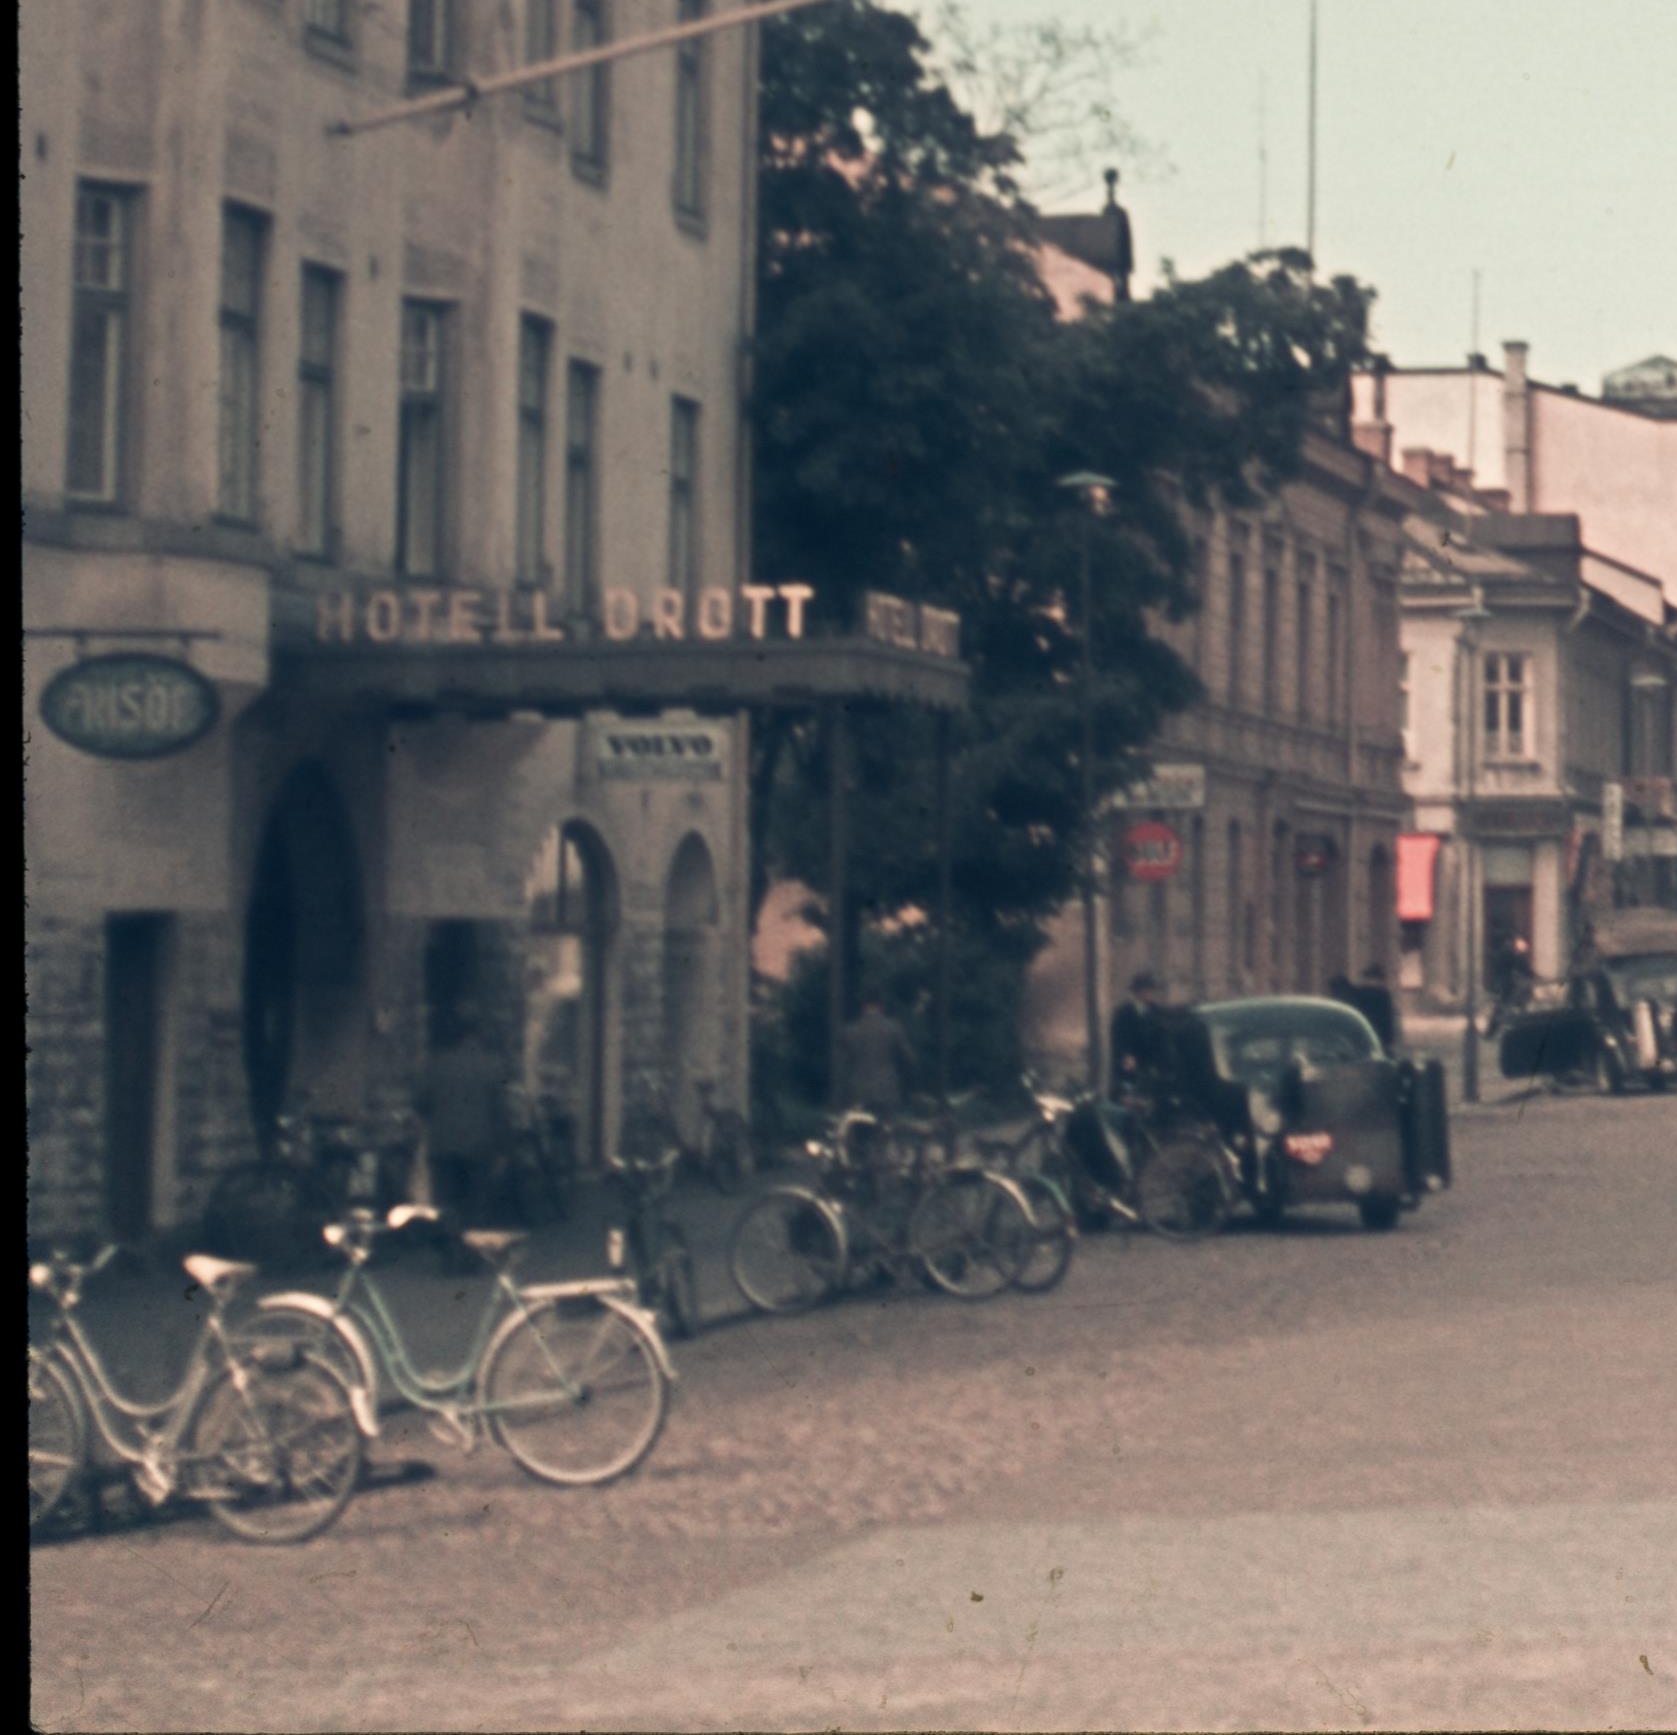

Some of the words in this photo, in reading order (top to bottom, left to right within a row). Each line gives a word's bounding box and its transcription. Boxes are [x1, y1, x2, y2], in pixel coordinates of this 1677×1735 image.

[315, 589, 565, 643] HOTELL
[604, 583, 815, 642] DROTT
[606, 734, 714, 756] VOLVO
